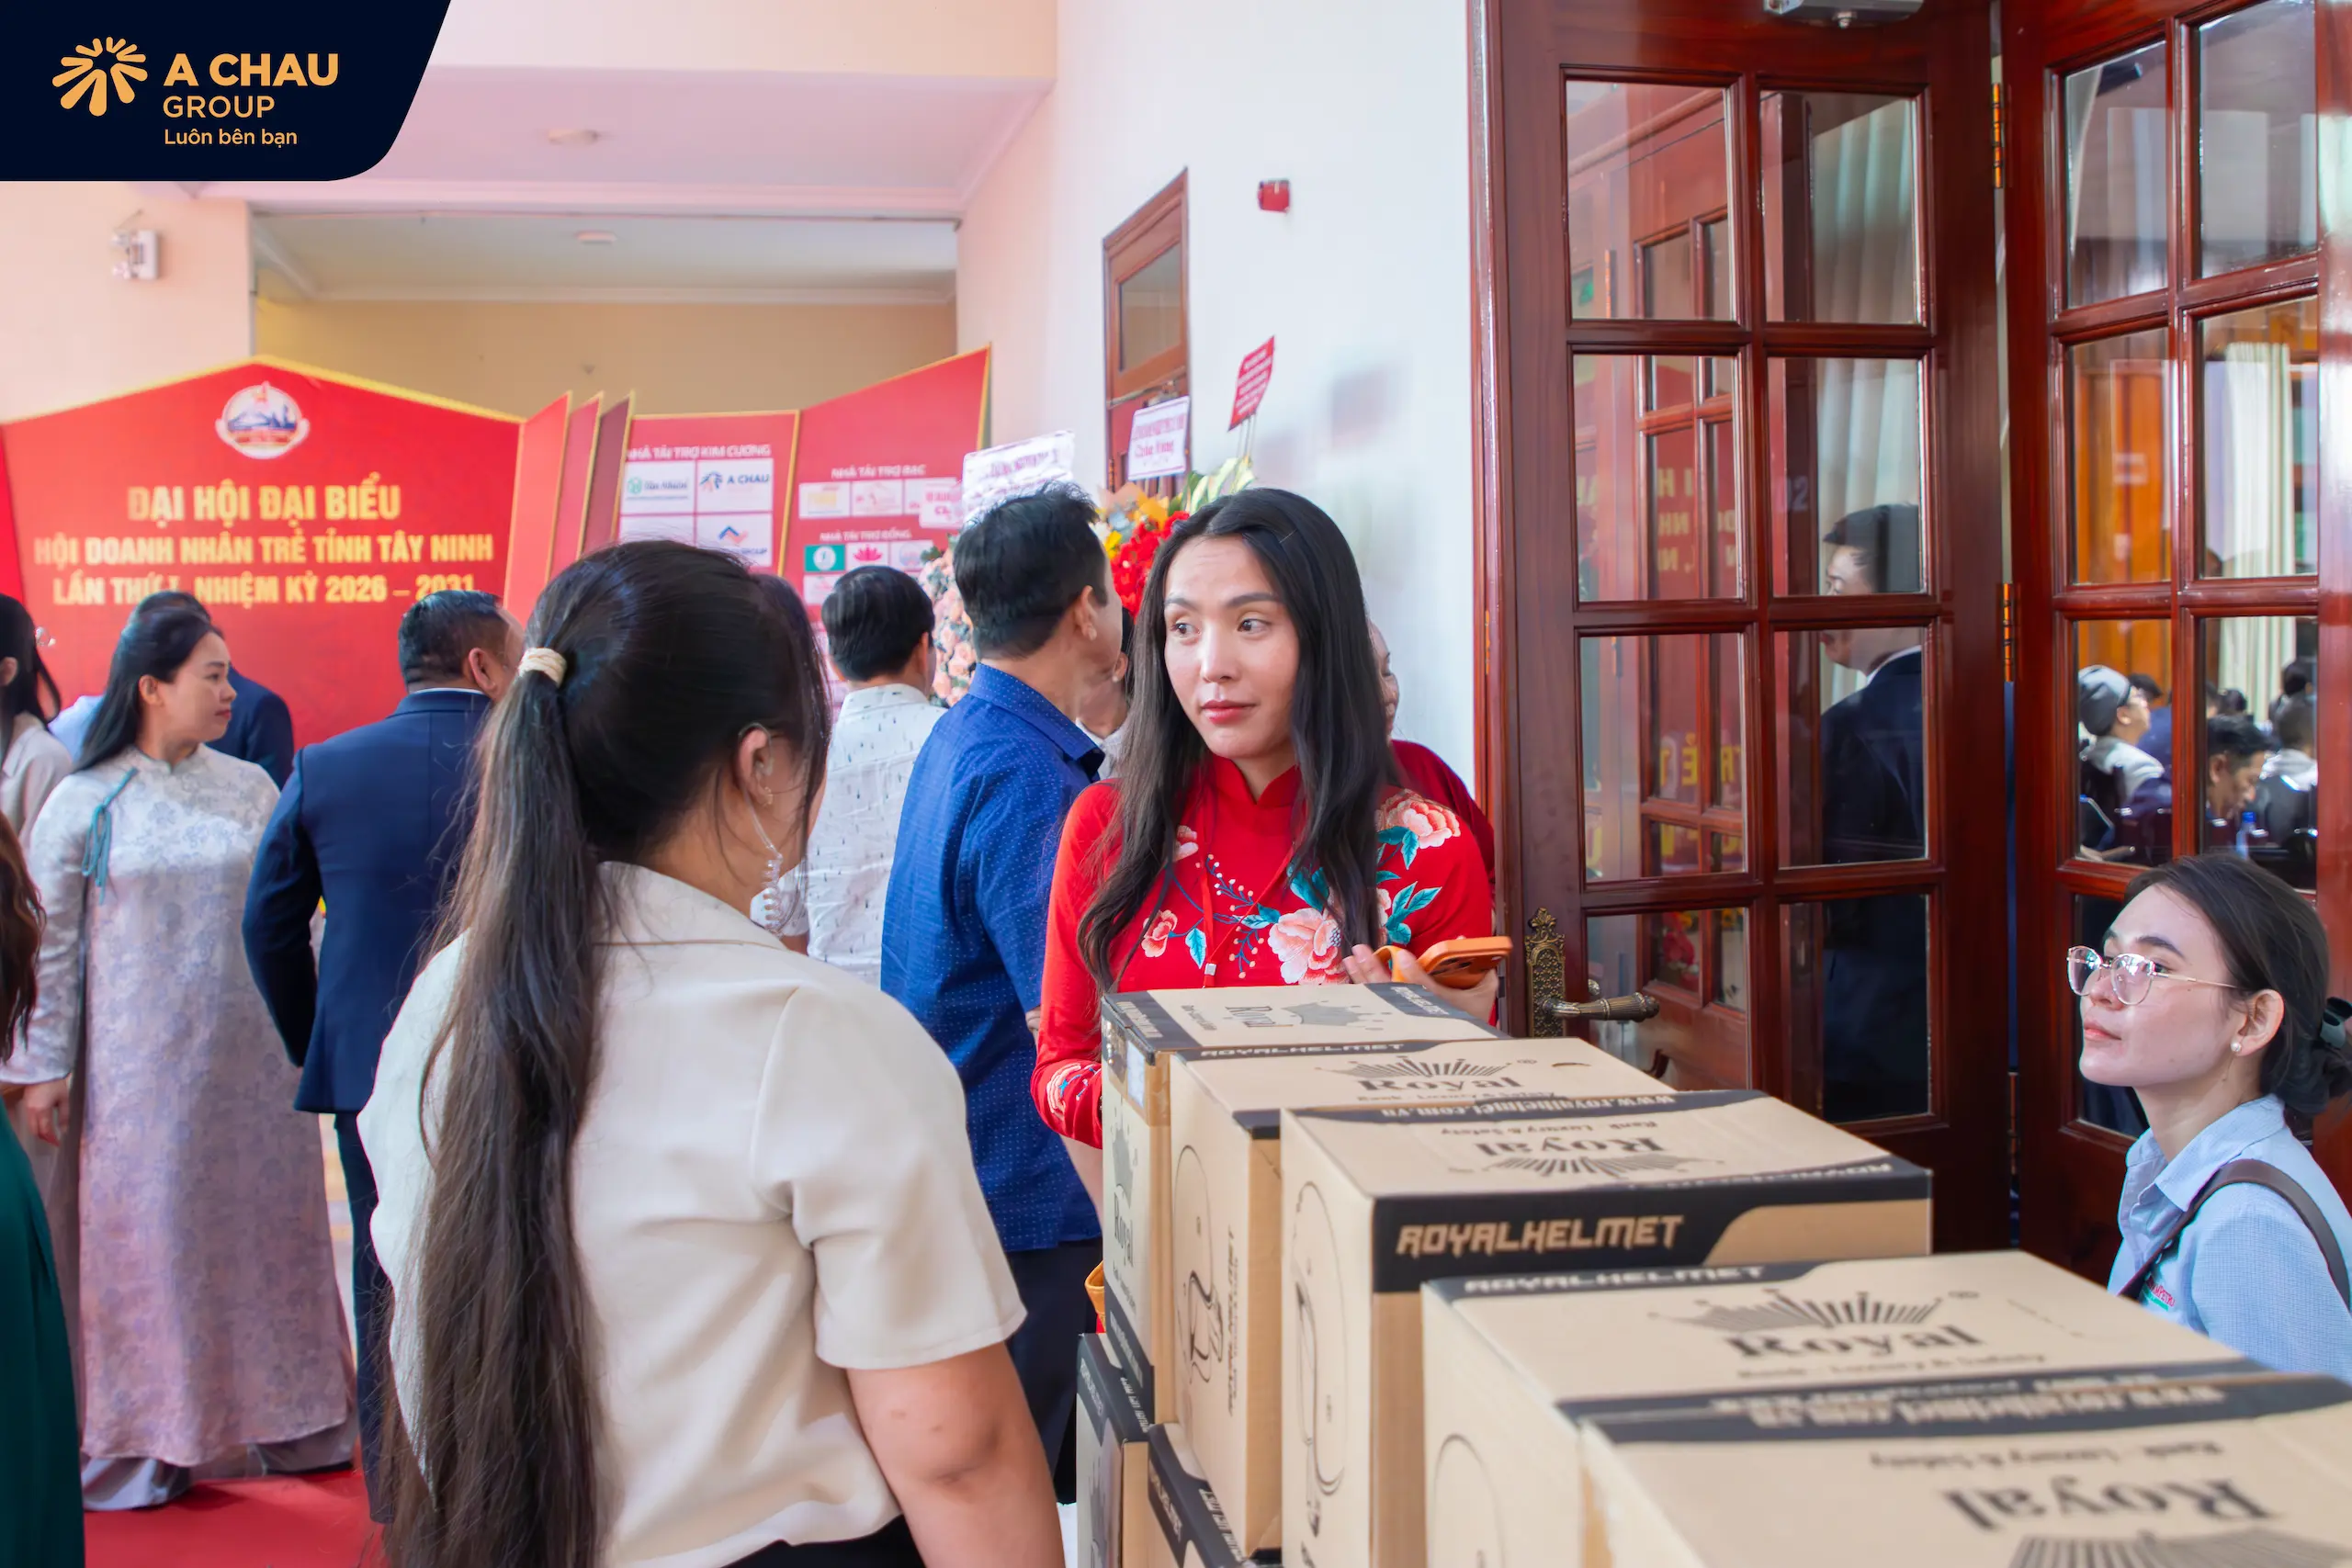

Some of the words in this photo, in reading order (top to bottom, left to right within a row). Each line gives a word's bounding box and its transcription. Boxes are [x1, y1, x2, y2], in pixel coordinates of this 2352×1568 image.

[193, 479, 251, 528] HỘI
[259, 485, 316, 528] ĐẠI
[325, 471, 401, 521] BIỂU
[34, 532, 79, 570] HỘI
[85, 536, 175, 565] DOANH
[180, 531, 254, 564] NHÂN
[258, 528, 307, 563] TRẺ
[312, 527, 371, 563] TỈNH
[377, 530, 424, 563] TÂY
[431, 534, 494, 562] NINH
[195, 570, 279, 609] NHIỆM
[325, 574, 388, 603] 2026
[1201, 1043, 1406, 1057] ROYALHELMET
[1358, 1077, 1524, 1092] Royal
[1475, 1137, 1665, 1156] Royal
[1396, 1214, 1685, 1259] ROYALHELMET
[1464, 1266, 1766, 1292] ROYALHELMET
[1725, 1325, 1985, 1358] Royal
[1941, 1476, 2280, 1532] Royal
